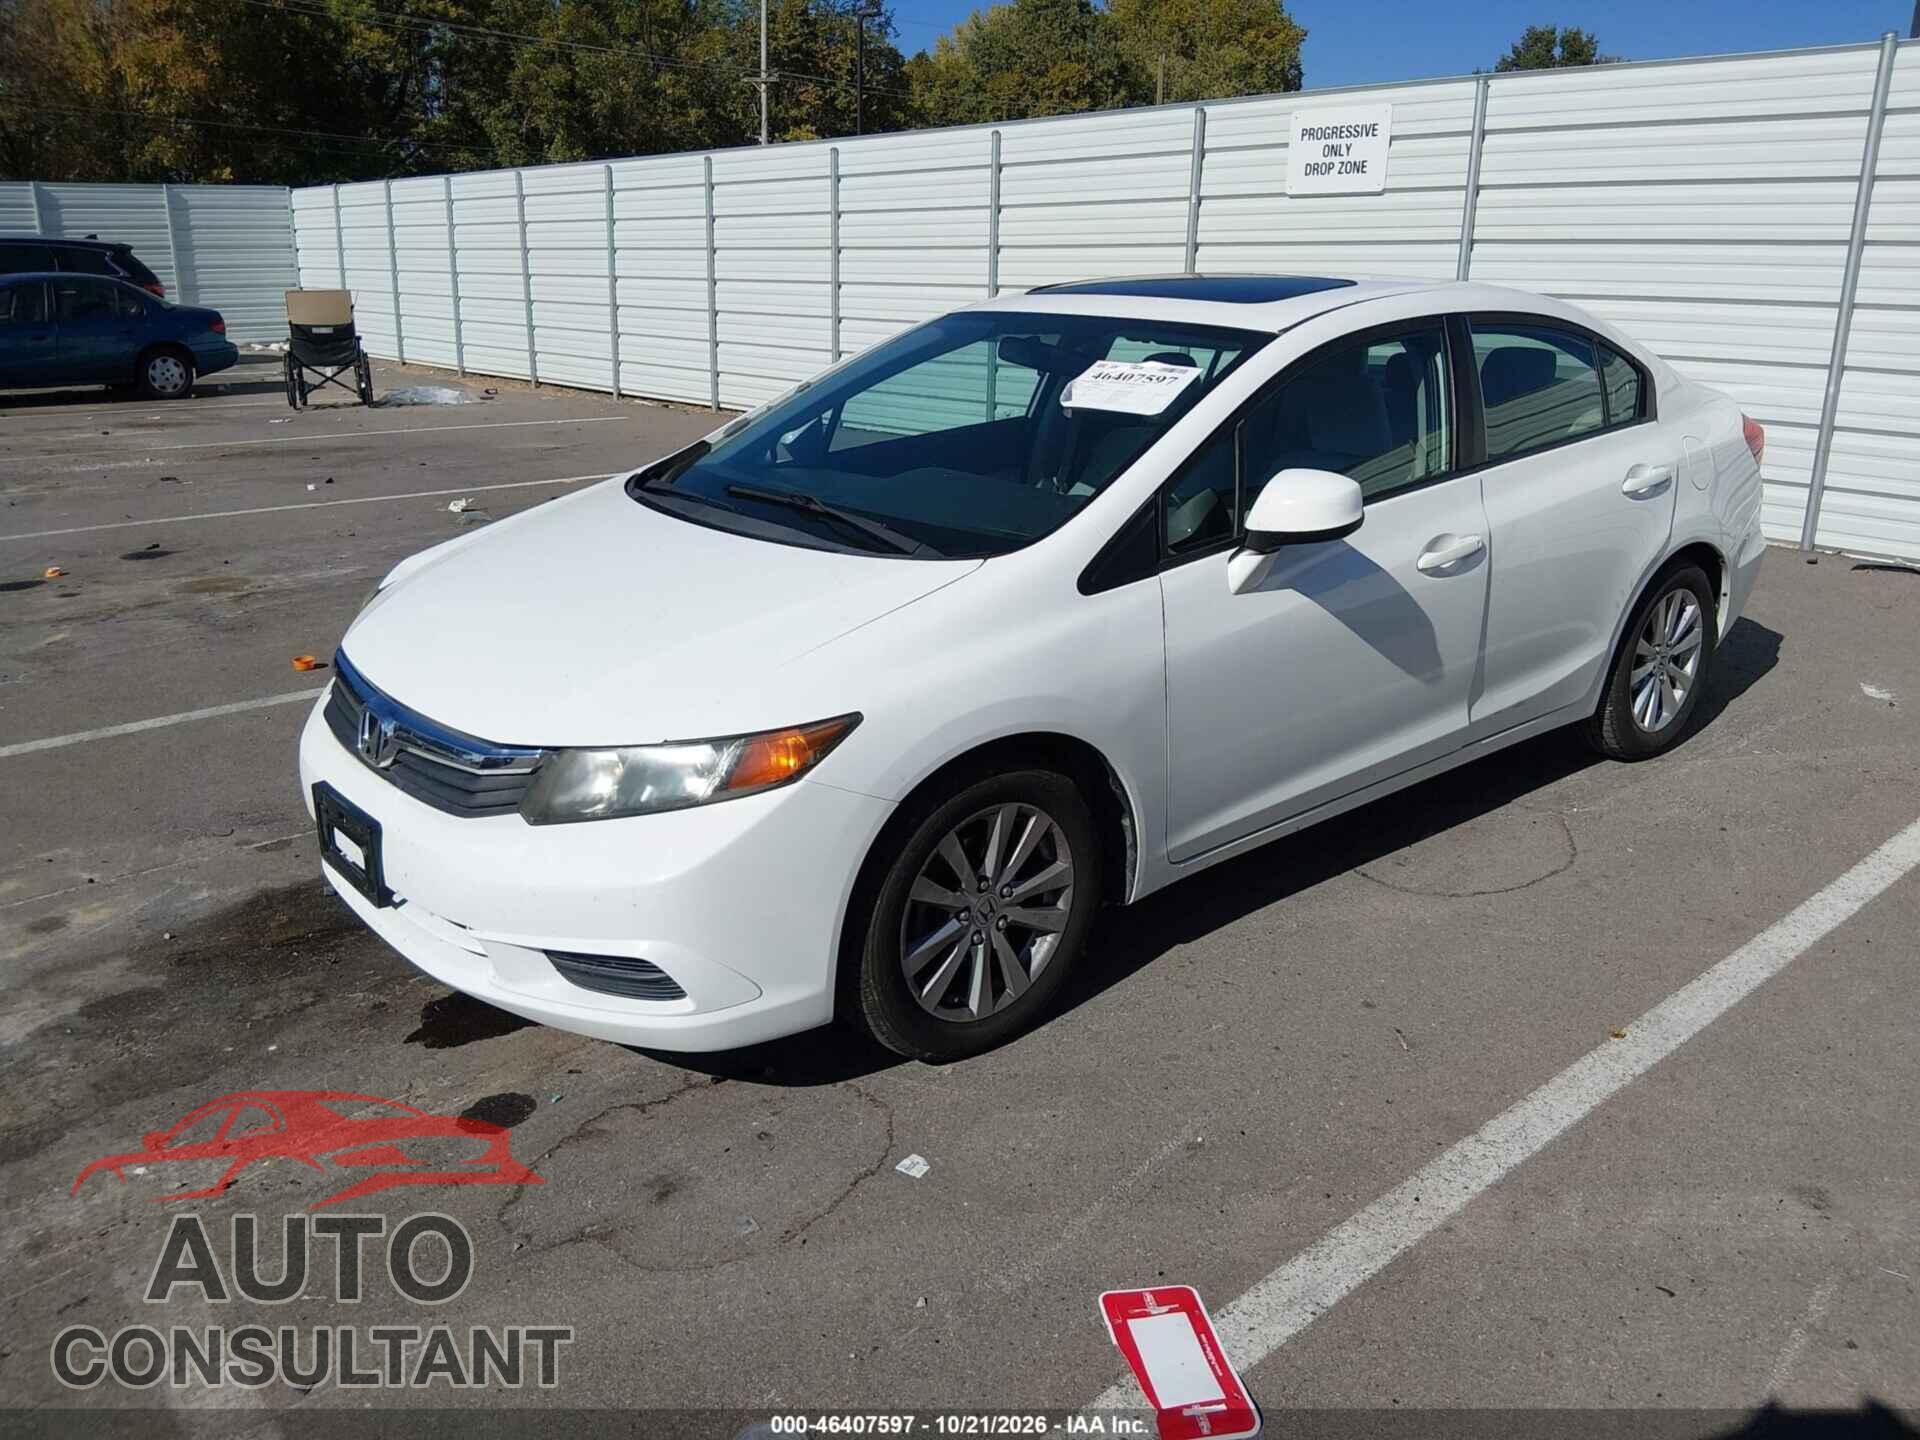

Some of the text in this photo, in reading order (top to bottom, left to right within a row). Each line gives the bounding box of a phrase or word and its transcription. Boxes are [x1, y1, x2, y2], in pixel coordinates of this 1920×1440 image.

[1301, 123, 1379, 141] PROGRESSIVE
[1322, 143, 1352, 158] ONLY
[1304, 160, 1367, 176] DROP ZONE
[1091, 371, 1179, 385] 46407597
